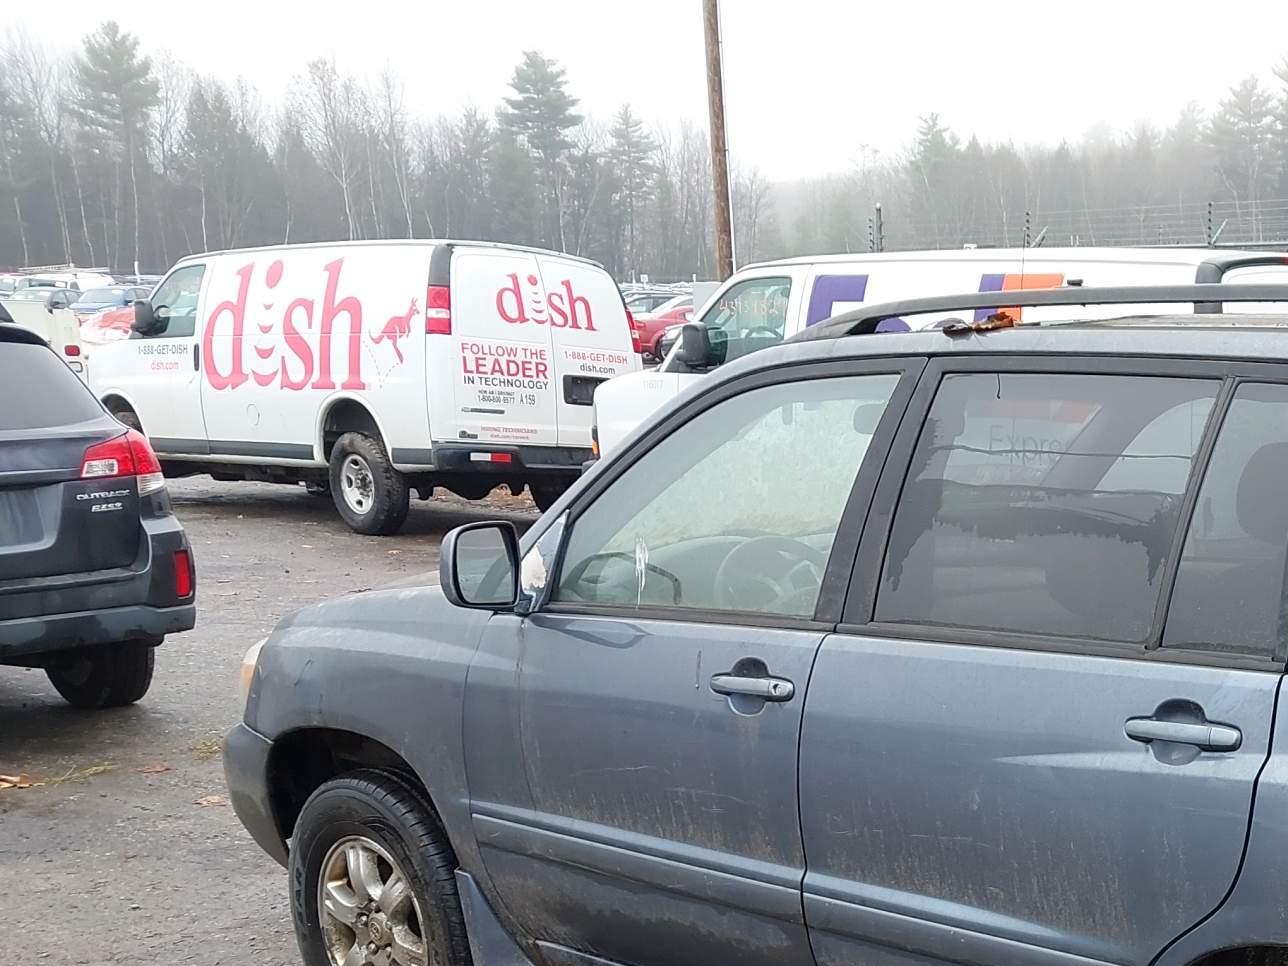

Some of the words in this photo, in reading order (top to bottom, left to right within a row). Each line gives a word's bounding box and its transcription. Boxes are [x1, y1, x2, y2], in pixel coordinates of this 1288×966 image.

[496, 272, 598, 331] dish
[203, 256, 366, 391] dish
[137, 343, 189, 355] 1-888-GET-DISH
[461, 342, 518, 358] FOLLOW
[521, 347, 547, 361] THE
[564, 351, 628, 365] 1-888-GET-DISH
[462, 355, 549, 379] LEADER
[579, 363, 616, 375] dish.com
[463, 375, 475, 386] IN
[478, 376, 549, 390] TECHNOLOGY
[76, 489, 130, 500] OUTBACK
